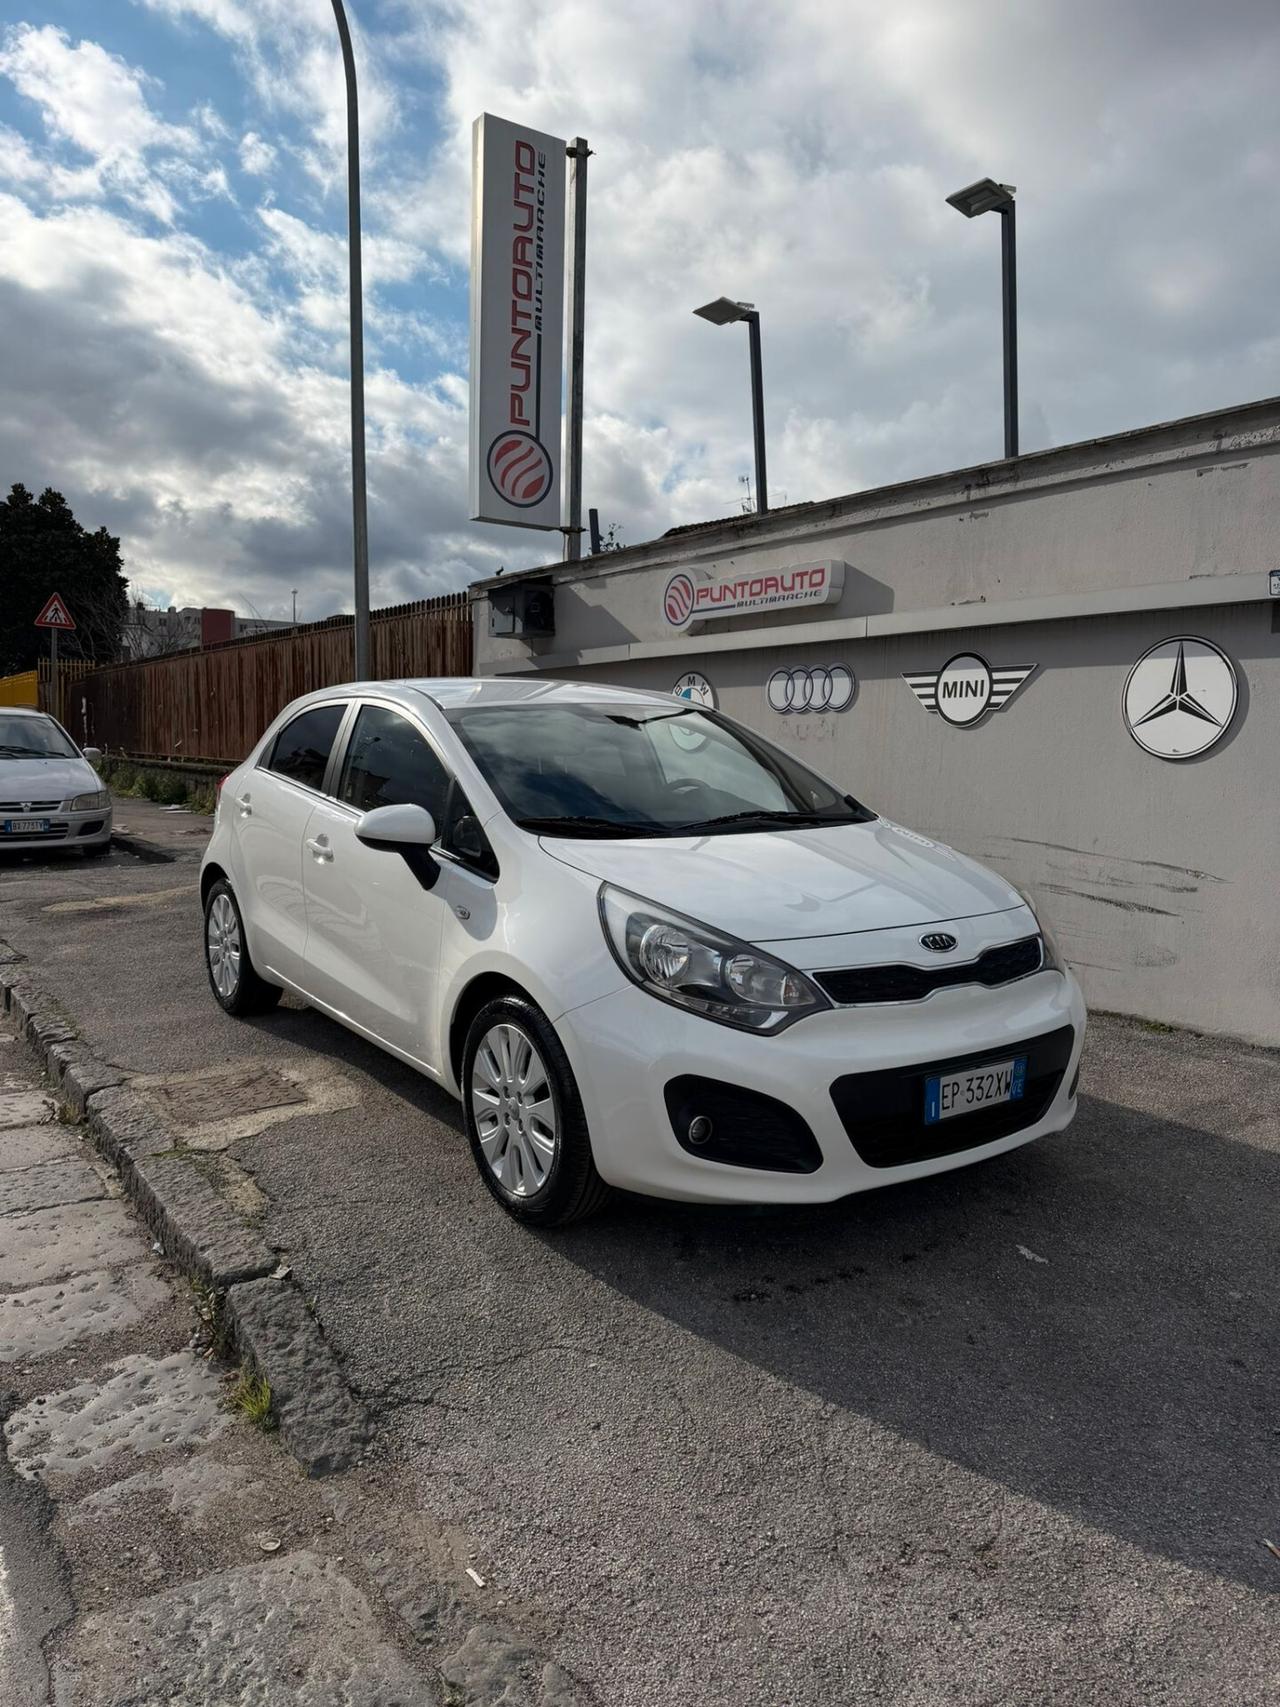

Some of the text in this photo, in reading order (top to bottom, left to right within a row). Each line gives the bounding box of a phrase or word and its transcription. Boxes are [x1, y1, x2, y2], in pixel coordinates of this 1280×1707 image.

[535, 151, 546, 332] MULTIMARCHE
[510, 140, 535, 426] PUNTOAUTO
[696, 568, 825, 605] PUNTOAUTO
[736, 590, 822, 608] MULTIMARCHE
[674, 675, 710, 697] BMW
[942, 680, 985, 698] MINI
[942, 1082, 960, 1111] EP
[966, 1069, 1013, 1104] 332XW
